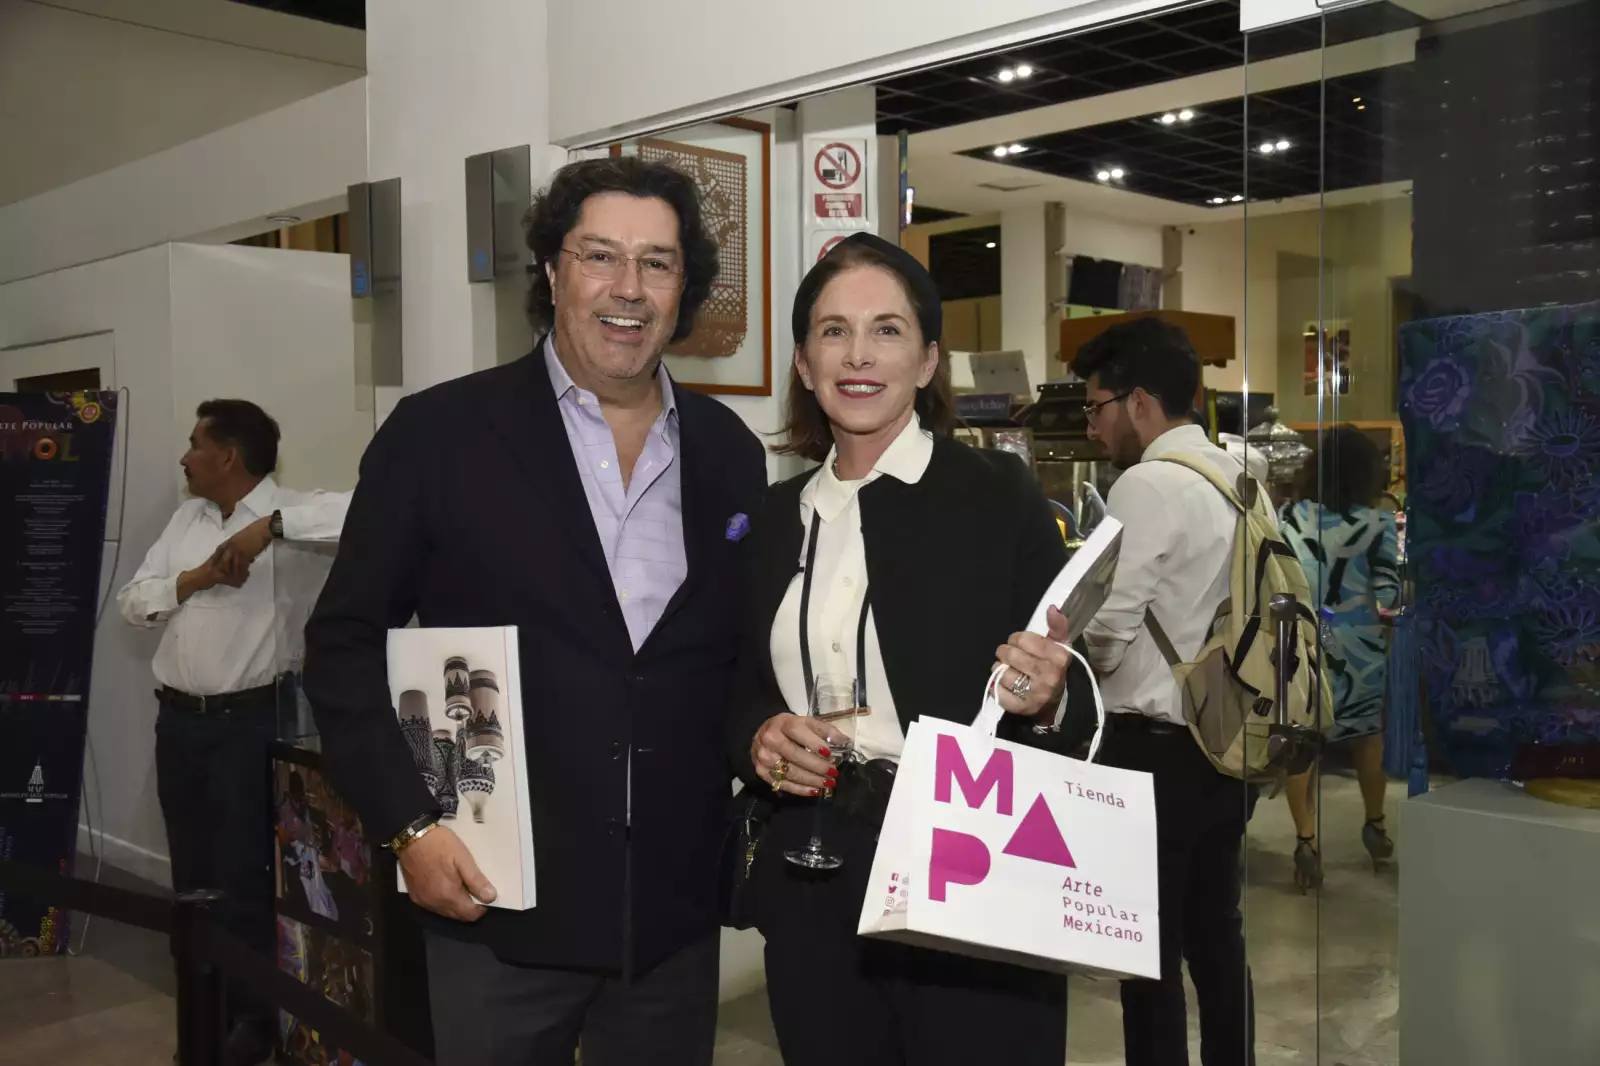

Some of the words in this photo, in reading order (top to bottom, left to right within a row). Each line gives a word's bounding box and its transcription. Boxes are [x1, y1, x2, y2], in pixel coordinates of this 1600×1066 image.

[22, 420, 74, 432] POPULAR
[1064, 780, 1126, 809] Tienda
[1062, 876, 1103, 897] Arte
[1062, 896, 1139, 923] Popular
[1063, 914, 1143, 943] Mexicano
